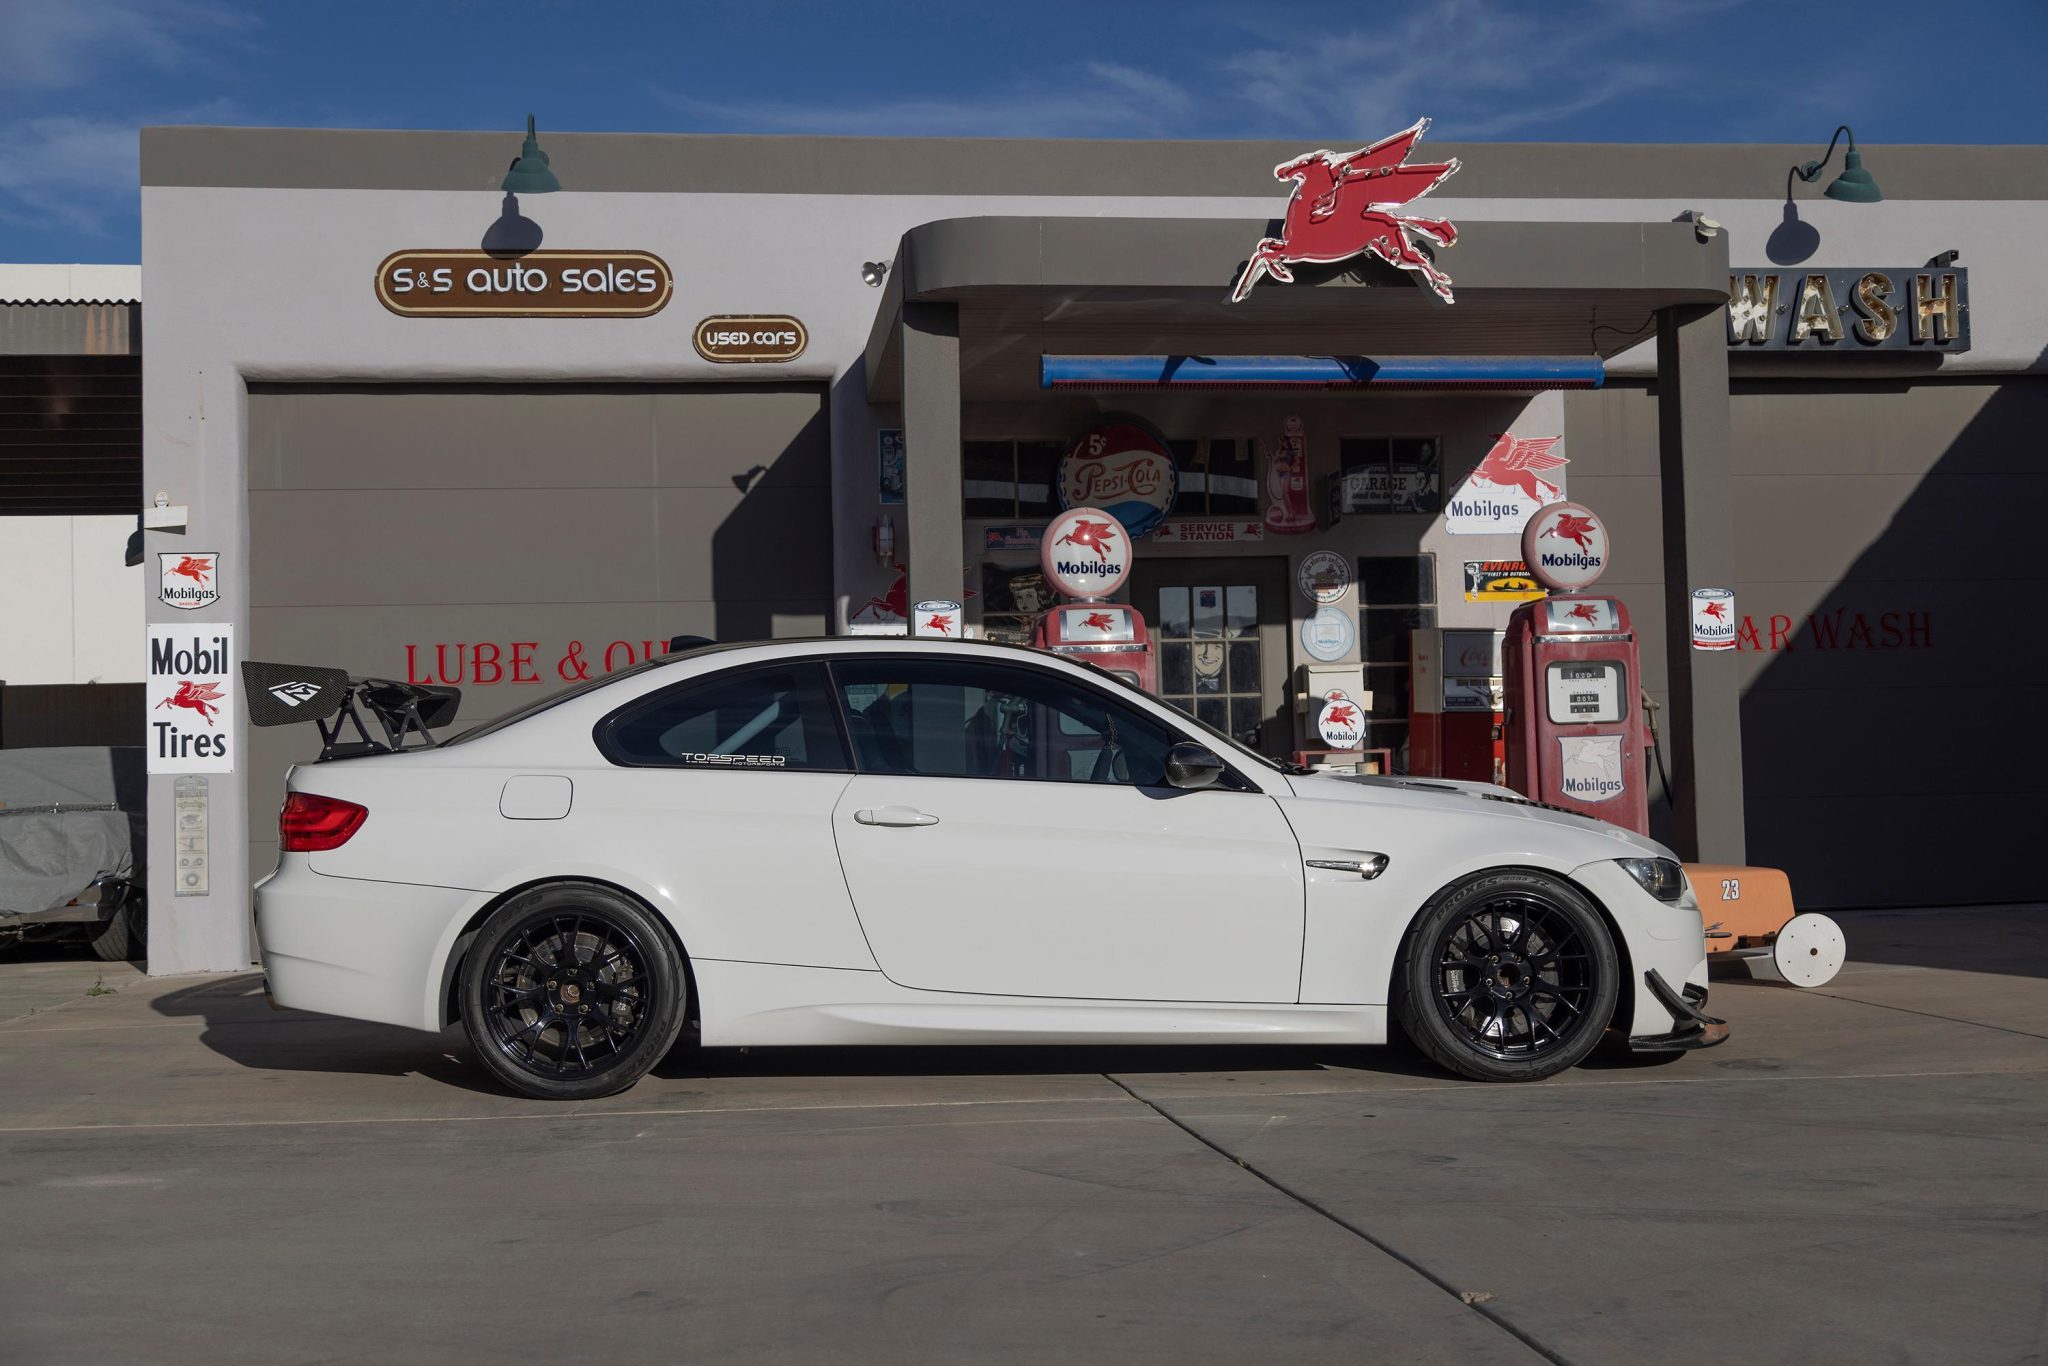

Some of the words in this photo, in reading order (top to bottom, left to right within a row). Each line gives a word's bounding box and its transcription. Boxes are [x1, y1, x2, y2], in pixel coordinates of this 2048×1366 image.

[467, 262, 547, 293] auto
[562, 263, 657, 293] sales
[1729, 272, 1960, 342] WASH
[706, 331, 750, 346] USED
[1451, 500, 1520, 521] Mobilgas
[1179, 523, 1234, 532] SERVICE
[1179, 532, 1234, 541] STATION
[1057, 561, 1122, 578] Mobilgas
[1482, 561, 1528, 572] EVINRU
[1541, 553, 1602, 570] Mobilgas
[164, 587, 215, 602] Mobilgas
[1694, 623, 1734, 636] Mobiloil
[1737, 615, 1796, 653] AR
[1808, 607, 1933, 650] WASH
[152, 637, 228, 675] Mobil
[404, 641, 541, 686] LUBE
[558, 640, 591, 682] &
[604, 640, 671, 673] OI
[153, 721, 227, 758] Tires
[1326, 731, 1357, 741] Mobiloil
[680, 752, 785, 763] TOPSPEED
[1566, 777, 1621, 795] Mobilgas
[1720, 879, 1740, 901] 23
[1436, 877, 1498, 921] PROXES
